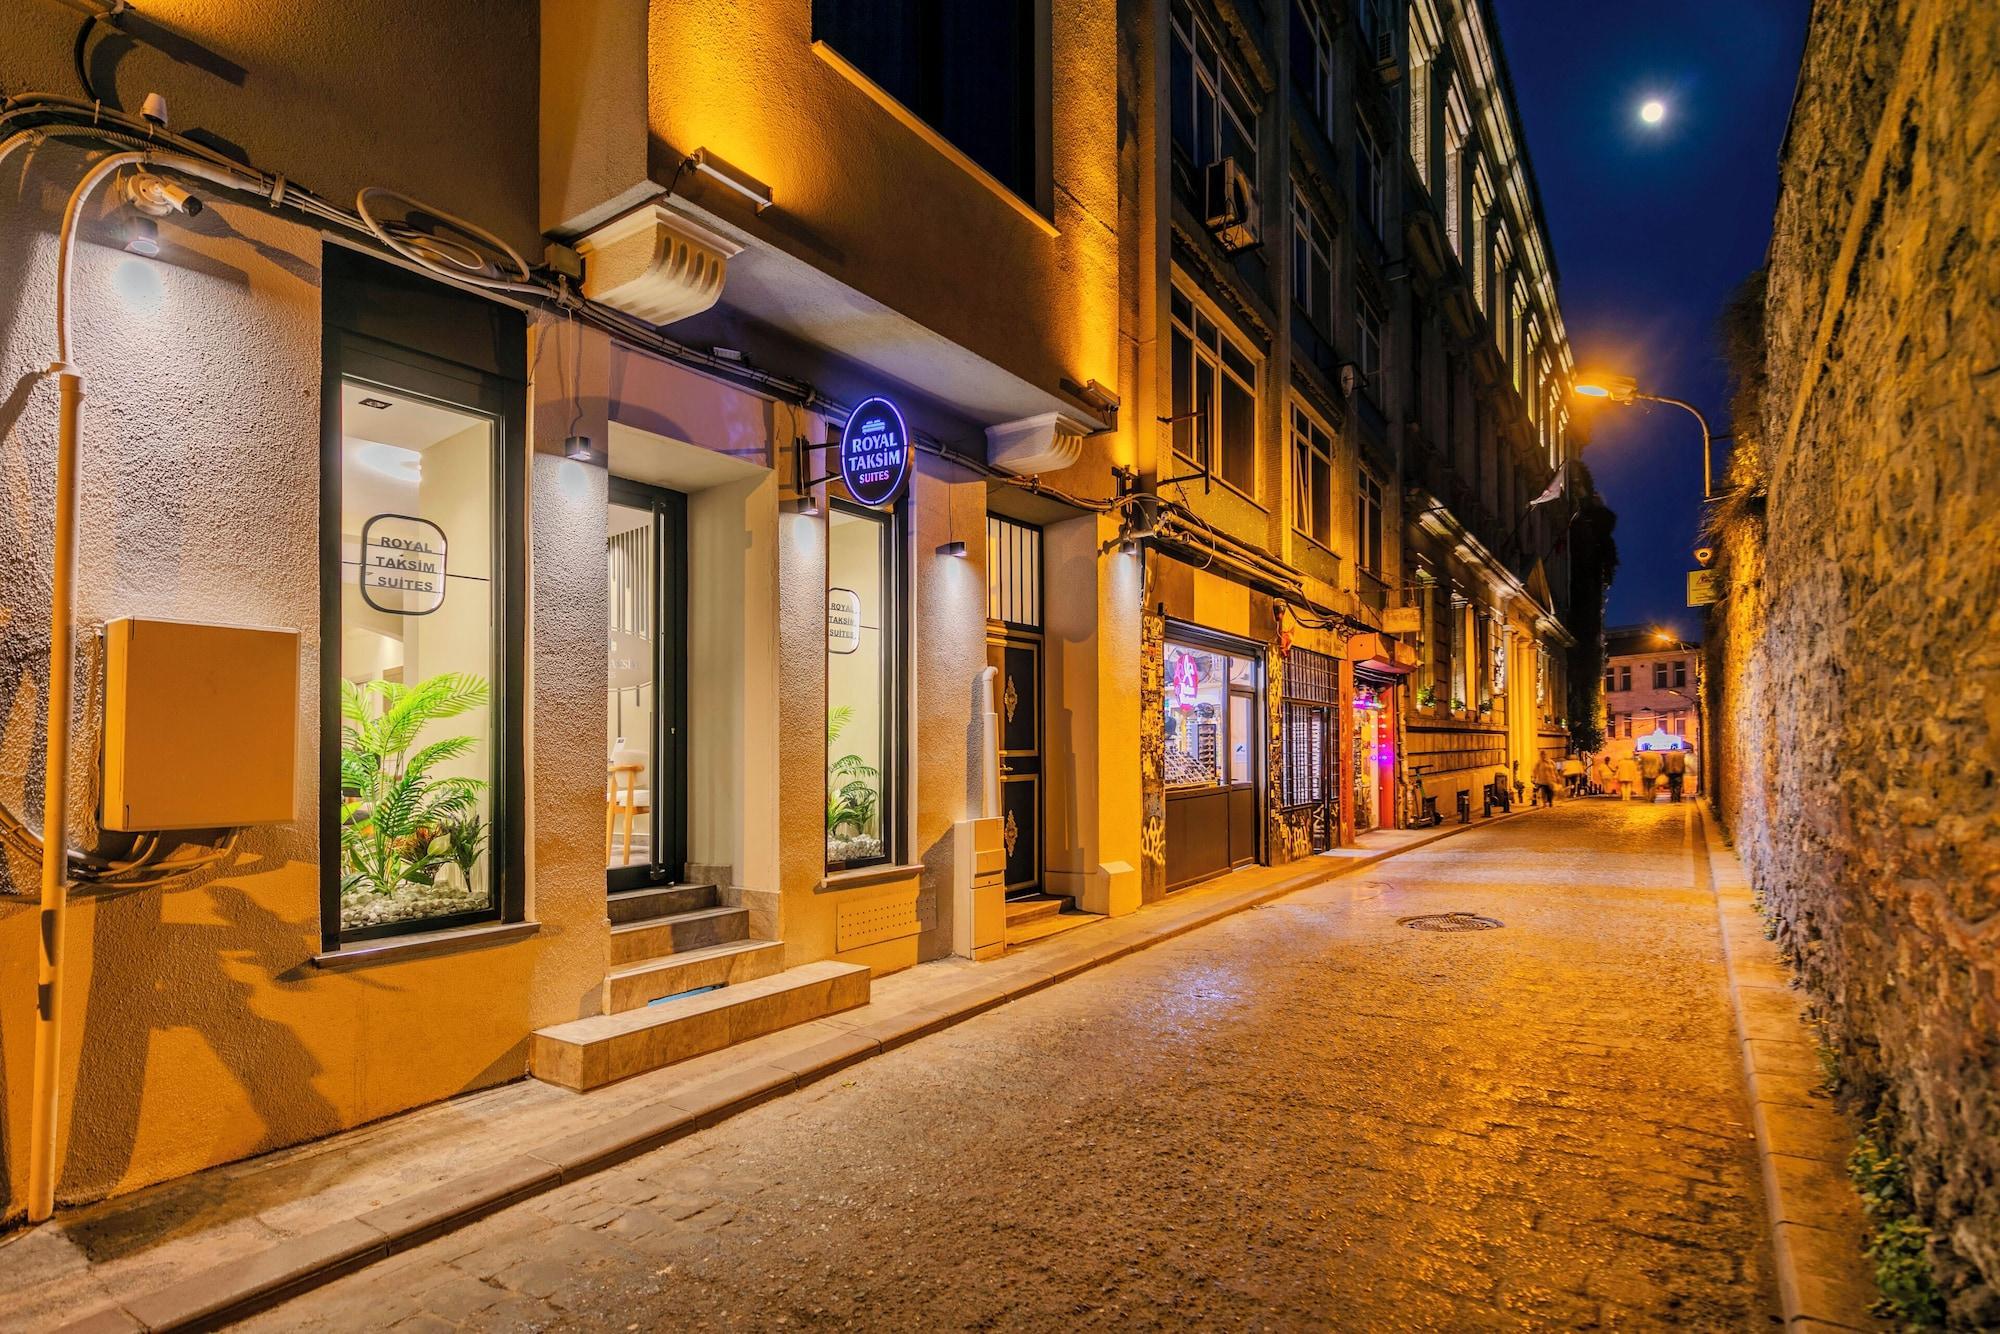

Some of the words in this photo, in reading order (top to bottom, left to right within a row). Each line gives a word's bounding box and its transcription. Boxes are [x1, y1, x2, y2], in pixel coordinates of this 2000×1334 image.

[852, 432, 898, 453] ROYAL
[848, 448, 901, 471] TAKSİM
[859, 470, 890, 484] SUITES
[381, 536, 433, 553] ROYAL
[376, 556, 435, 573] TAKSİM
[378, 576, 433, 592] SUİTES
